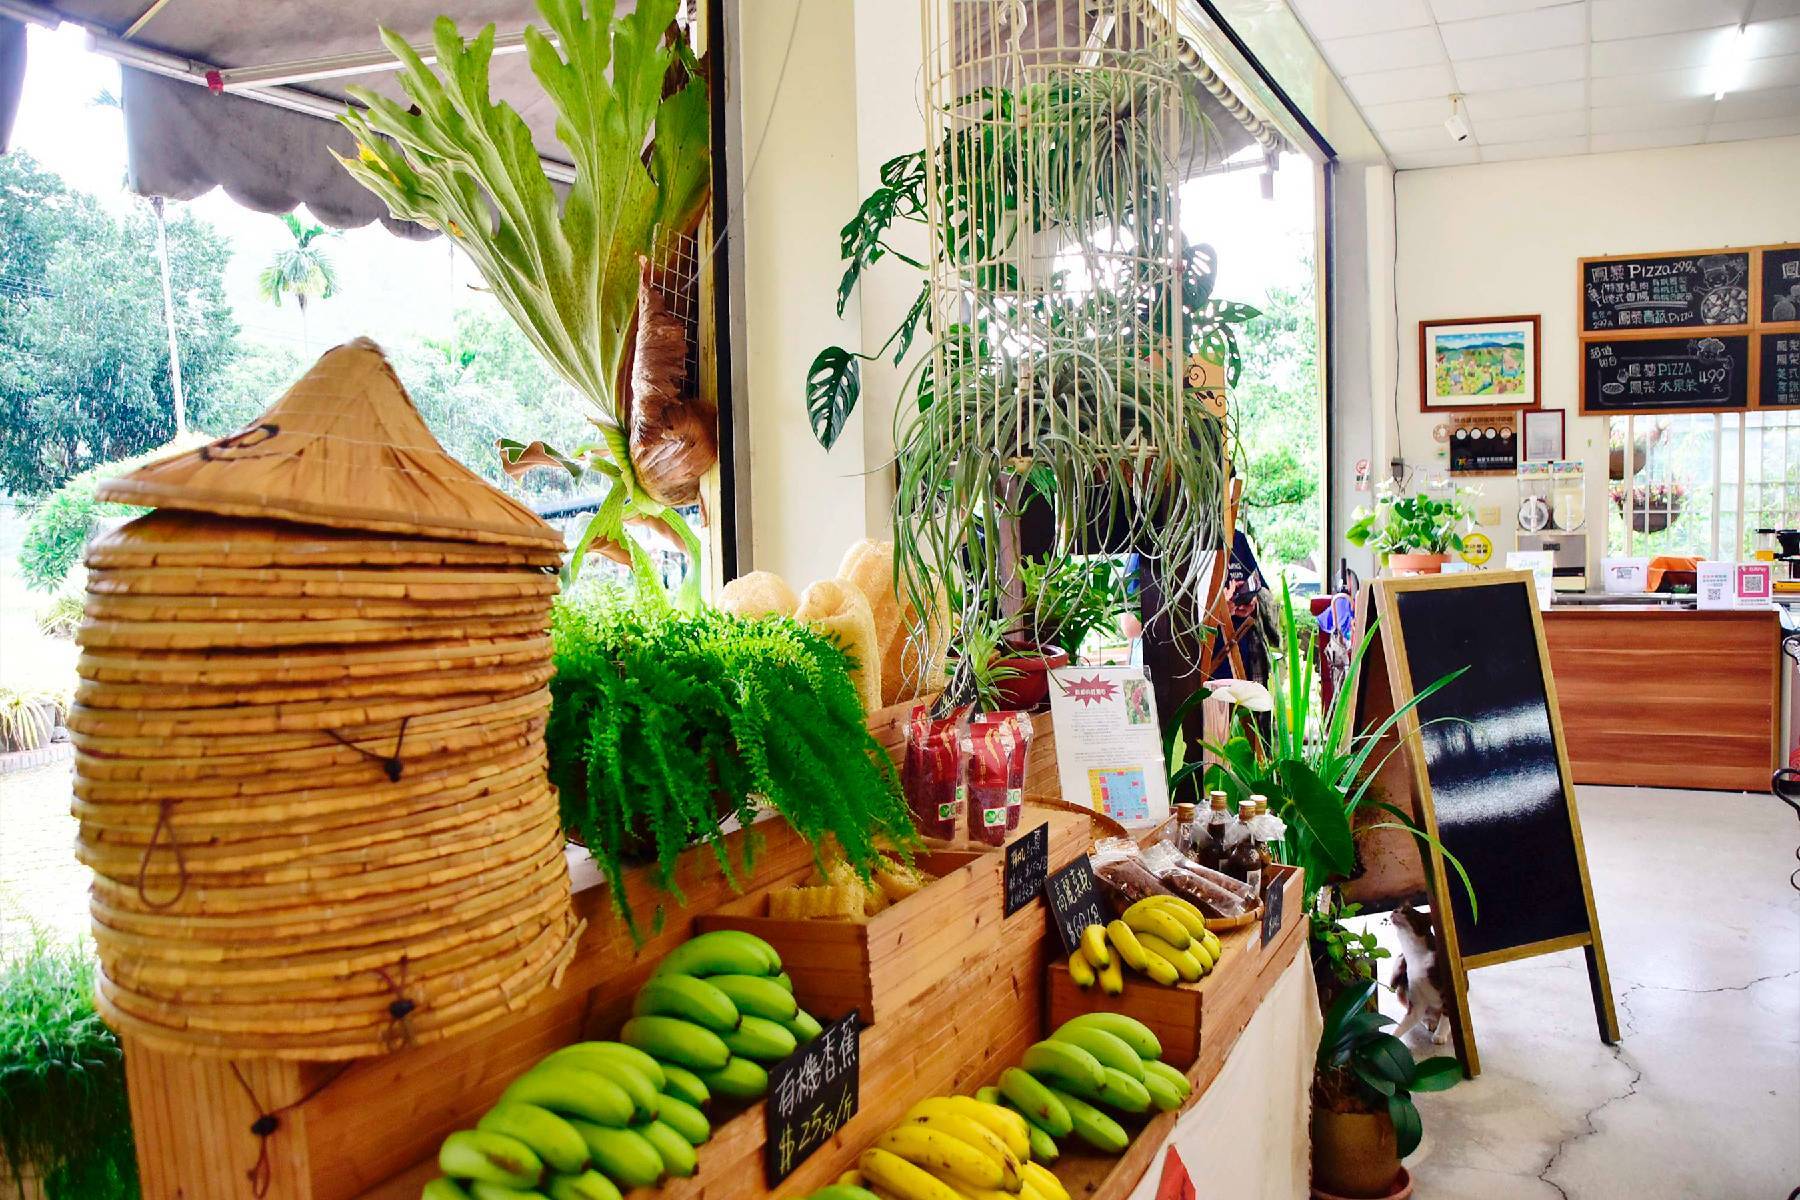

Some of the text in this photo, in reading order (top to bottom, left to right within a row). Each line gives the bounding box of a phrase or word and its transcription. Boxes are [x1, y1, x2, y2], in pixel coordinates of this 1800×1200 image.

[1698, 368, 1726, 384] 499
[774, 1012, 857, 1117] 有機香蕉
